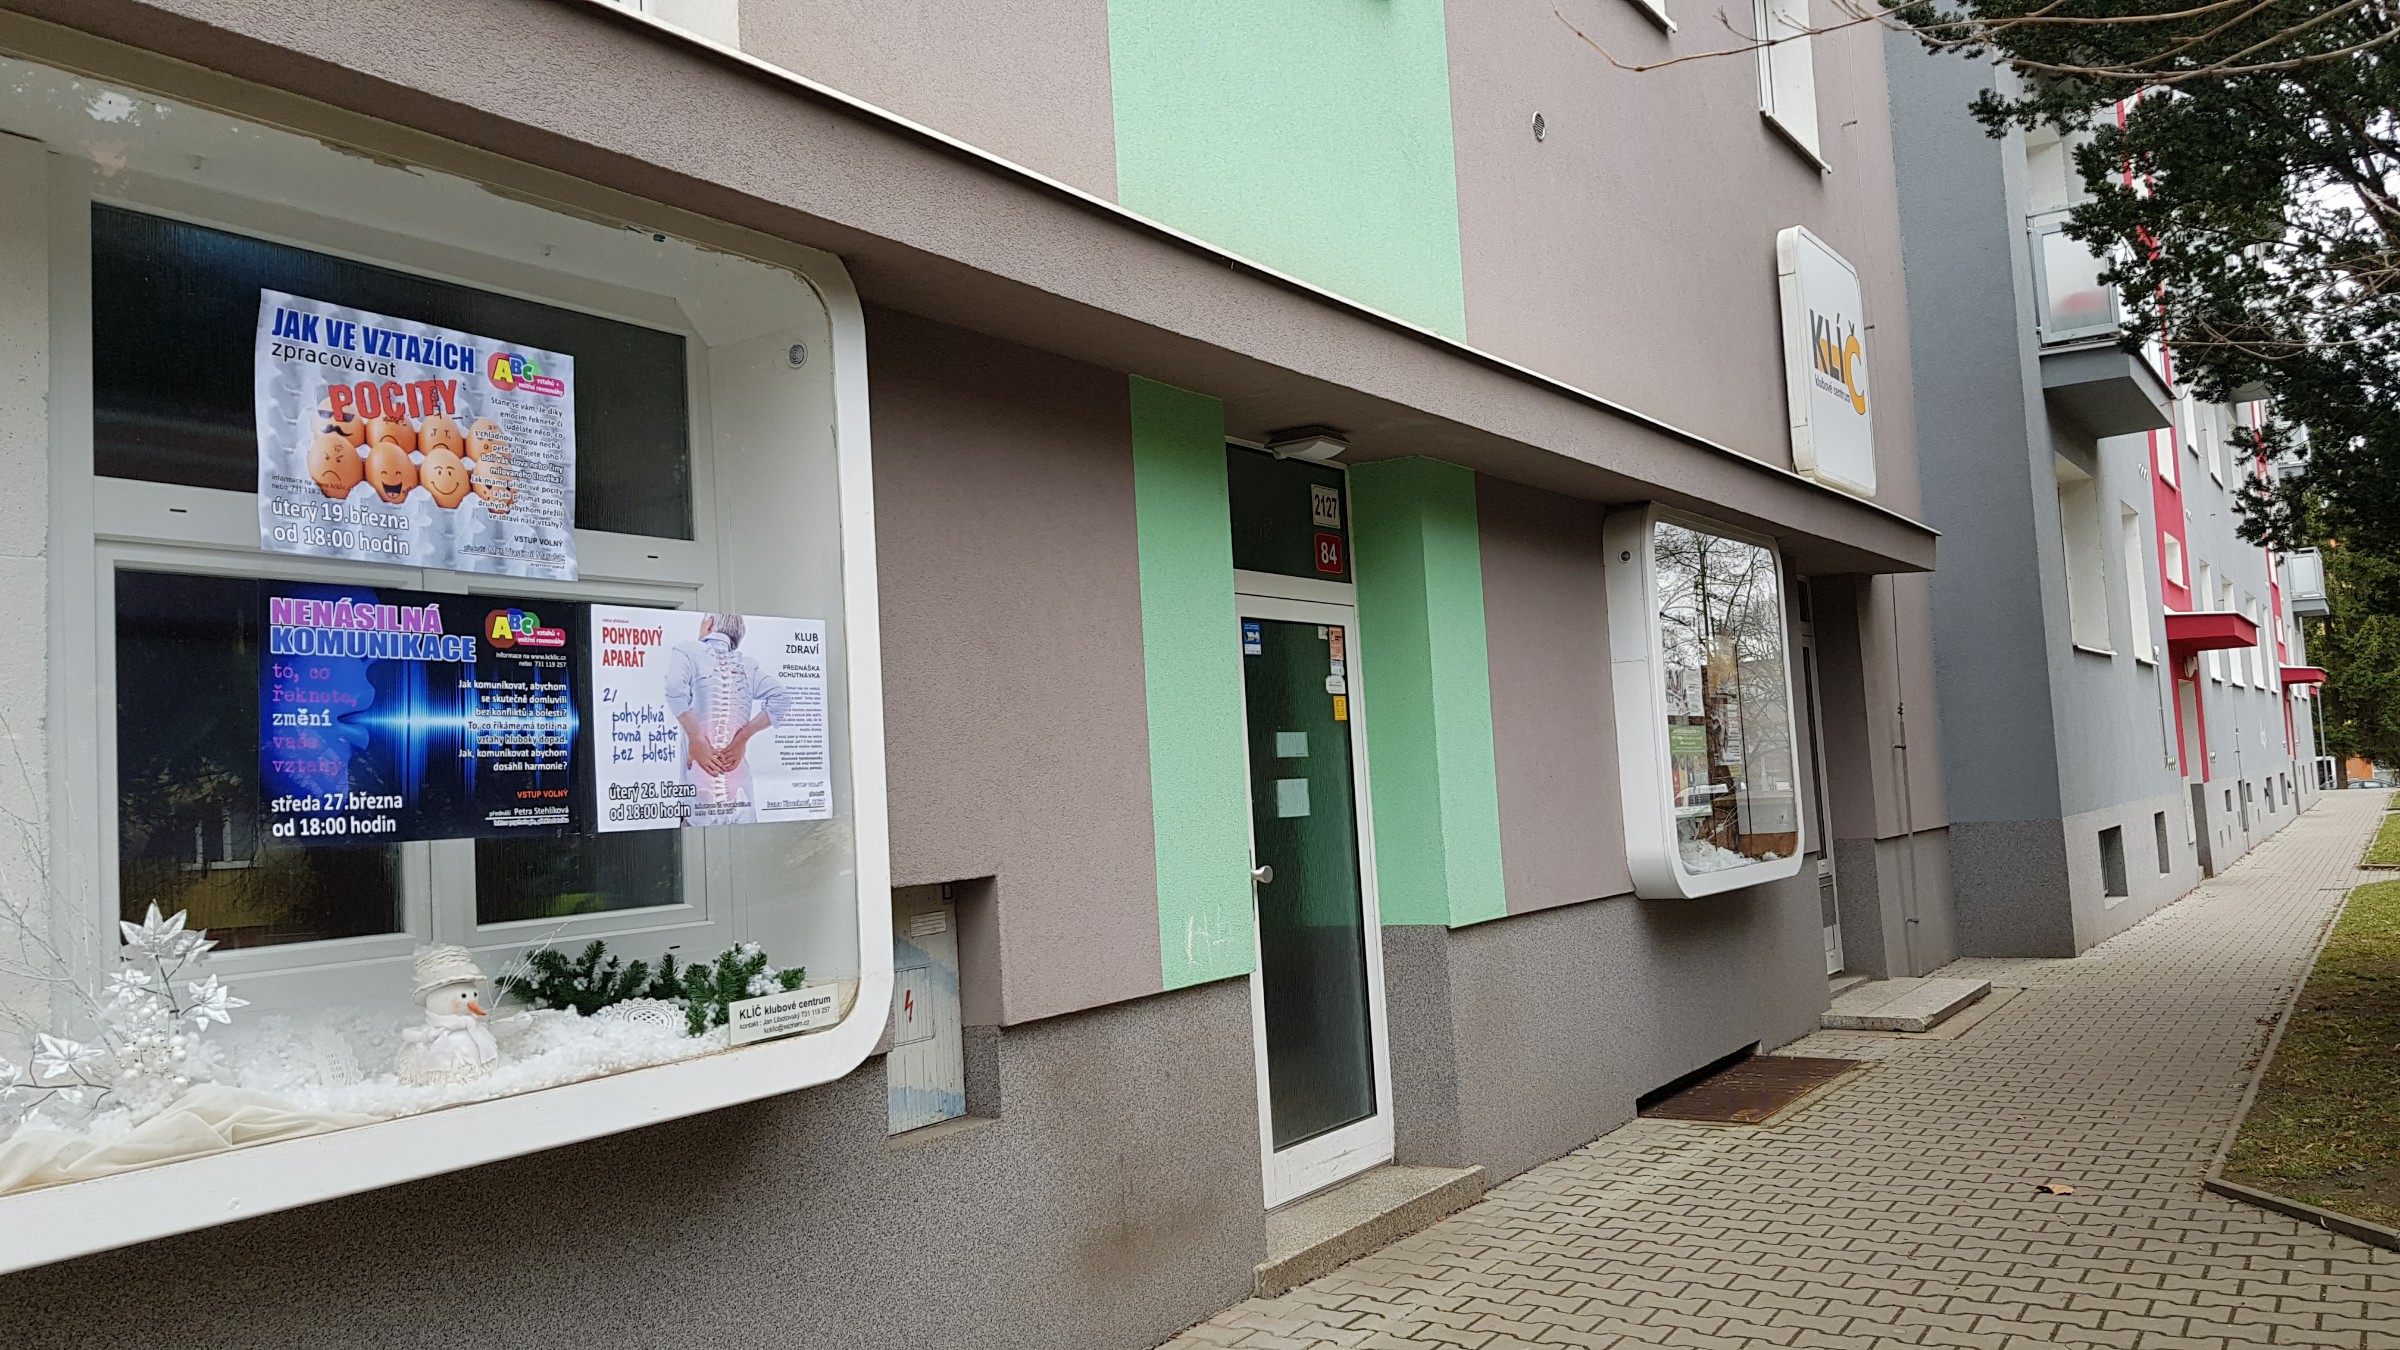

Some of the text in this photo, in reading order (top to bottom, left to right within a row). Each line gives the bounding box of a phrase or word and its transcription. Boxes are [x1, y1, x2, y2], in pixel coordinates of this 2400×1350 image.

[272, 308, 475, 373] JAK VE VZTAZÍCH
[272, 342, 396, 377] zpracovávat
[1810, 309, 1866, 415] KLÍČ
[493, 357, 533, 383] ABC
[328, 379, 457, 423] POCITY
[491, 397, 510, 407] Stane
[548, 407, 562, 417] díky
[506, 424, 532, 434] uděláte
[528, 416, 555, 426] řeknete
[480, 431, 512, 442] chladnou
[514, 436, 538, 446] hlavou
[493, 445, 508, 453] pete
[516, 448, 541, 457] litujete
[543, 452, 564, 460] toho?
[490, 467, 532, 479] milovaného
[510, 459, 528, 467] slova
[530, 462, 548, 470] nebo
[272, 474, 302, 484] informace
[500, 491, 510, 499] jak
[542, 496, 563, 506] pocity
[542, 485, 563, 495] pocity
[272, 496, 409, 530] úterý 19.března
[511, 504, 540, 514] abychom
[1314, 494, 1337, 520] 2127
[274, 523, 410, 555] od 18:00 hodin
[514, 536, 563, 548] VSTUP VOLNÝ
[1320, 542, 1337, 565] 84
[270, 597, 443, 634] NENÁSILNÁ
[492, 614, 534, 640] ABC
[602, 626, 662, 646] POHYBOVÝ
[270, 625, 477, 662] KOMUNIKACE
[794, 632, 818, 642] KLUB
[602, 647, 645, 667] APARÁT
[786, 644, 819, 654] ZDRAVÍ
[272, 663, 330, 682] to, co
[778, 670, 820, 678] OCHUTNÁVKA
[458, 680, 566, 692] Jak komunikovat, abychom
[603, 688, 618, 702] 2/
[272, 684, 357, 707] řeknete,
[492, 695, 527, 704] skutečně
[529, 695, 567, 704] domluvili
[272, 708, 332, 726] změní
[476, 708, 489, 716] bez
[492, 708, 526, 716] konfliktů
[612, 702, 664, 730] pohyblivá
[468, 722, 480, 730] To,
[494, 722, 521, 730] říkáme
[523, 722, 534, 730] má
[536, 722, 554, 730] totiž
[477, 735, 504, 745] vztahy
[505, 735, 537, 745] hluboký
[612, 724, 678, 750] rovná páteř
[459, 749, 567, 758] Jak, komunikovat abychom
[613, 743, 676, 763] bez bolesti
[272, 758, 342, 776] vztahy
[493, 762, 567, 771] dosáhli harmonie?
[543, 789, 568, 798] VOLNÝ
[609, 781, 696, 802] úterý 26. března
[272, 792, 403, 812] středa 27.března
[534, 806, 569, 814] Stehlíková
[610, 804, 624, 821] od
[627, 804, 658, 820] 18:00
[660, 801, 691, 818] hodin
[272, 815, 396, 836] od 18:00 hodin
[740, 996, 831, 1020] KLÍČ klubové centrum
[740, 1020, 758, 1030] kontakt
[763, 1018, 773, 1026] Jan
[801, 1010, 810, 1018] 731
[821, 1006, 830, 1014] 257
